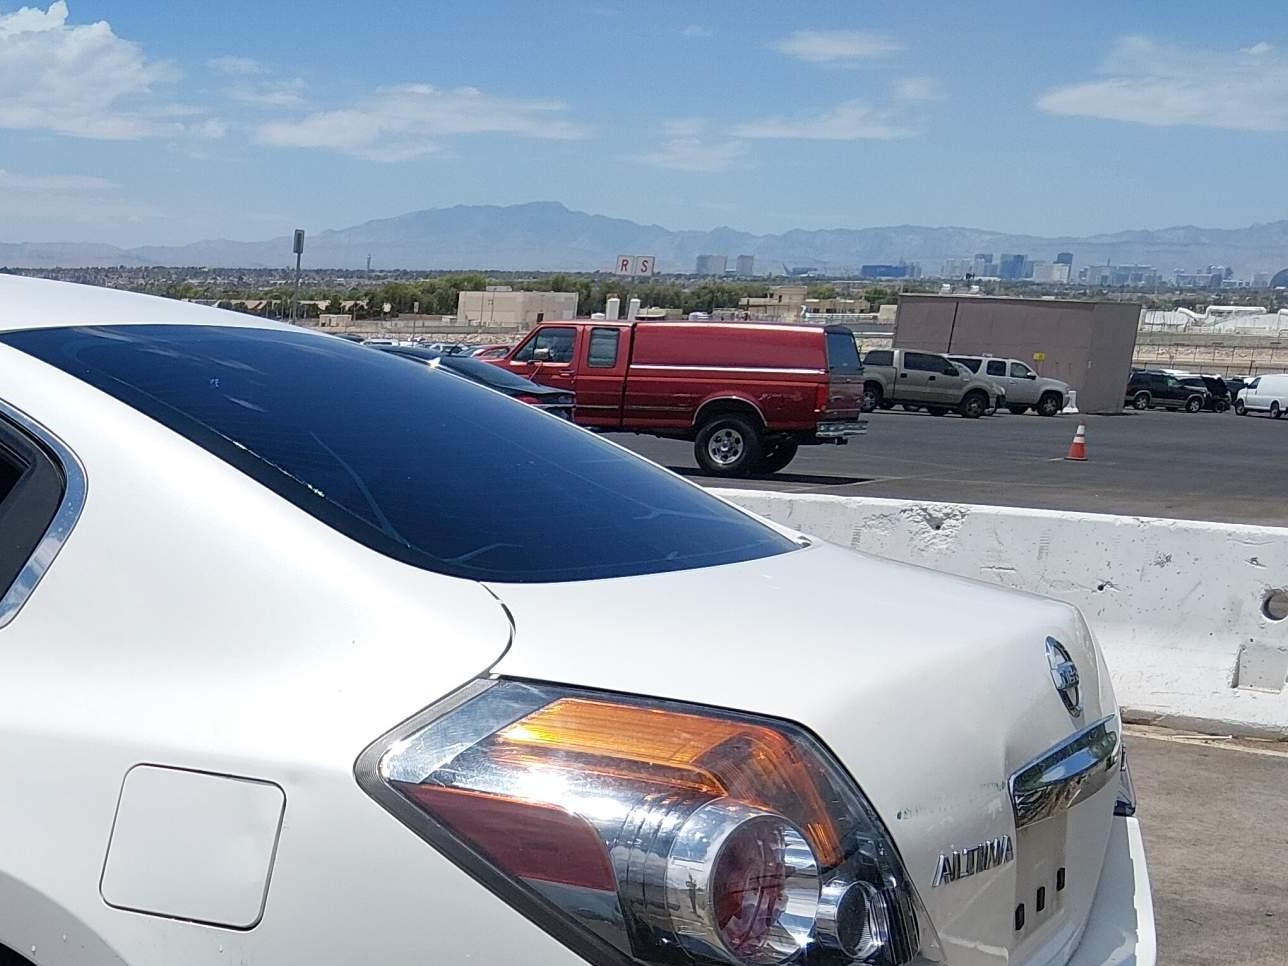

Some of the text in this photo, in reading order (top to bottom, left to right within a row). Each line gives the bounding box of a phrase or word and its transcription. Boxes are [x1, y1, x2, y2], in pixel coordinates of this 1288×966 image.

[620, 258, 630, 272] R
[640, 259, 649, 273] S
[931, 834, 1014, 888] ALTIMA
